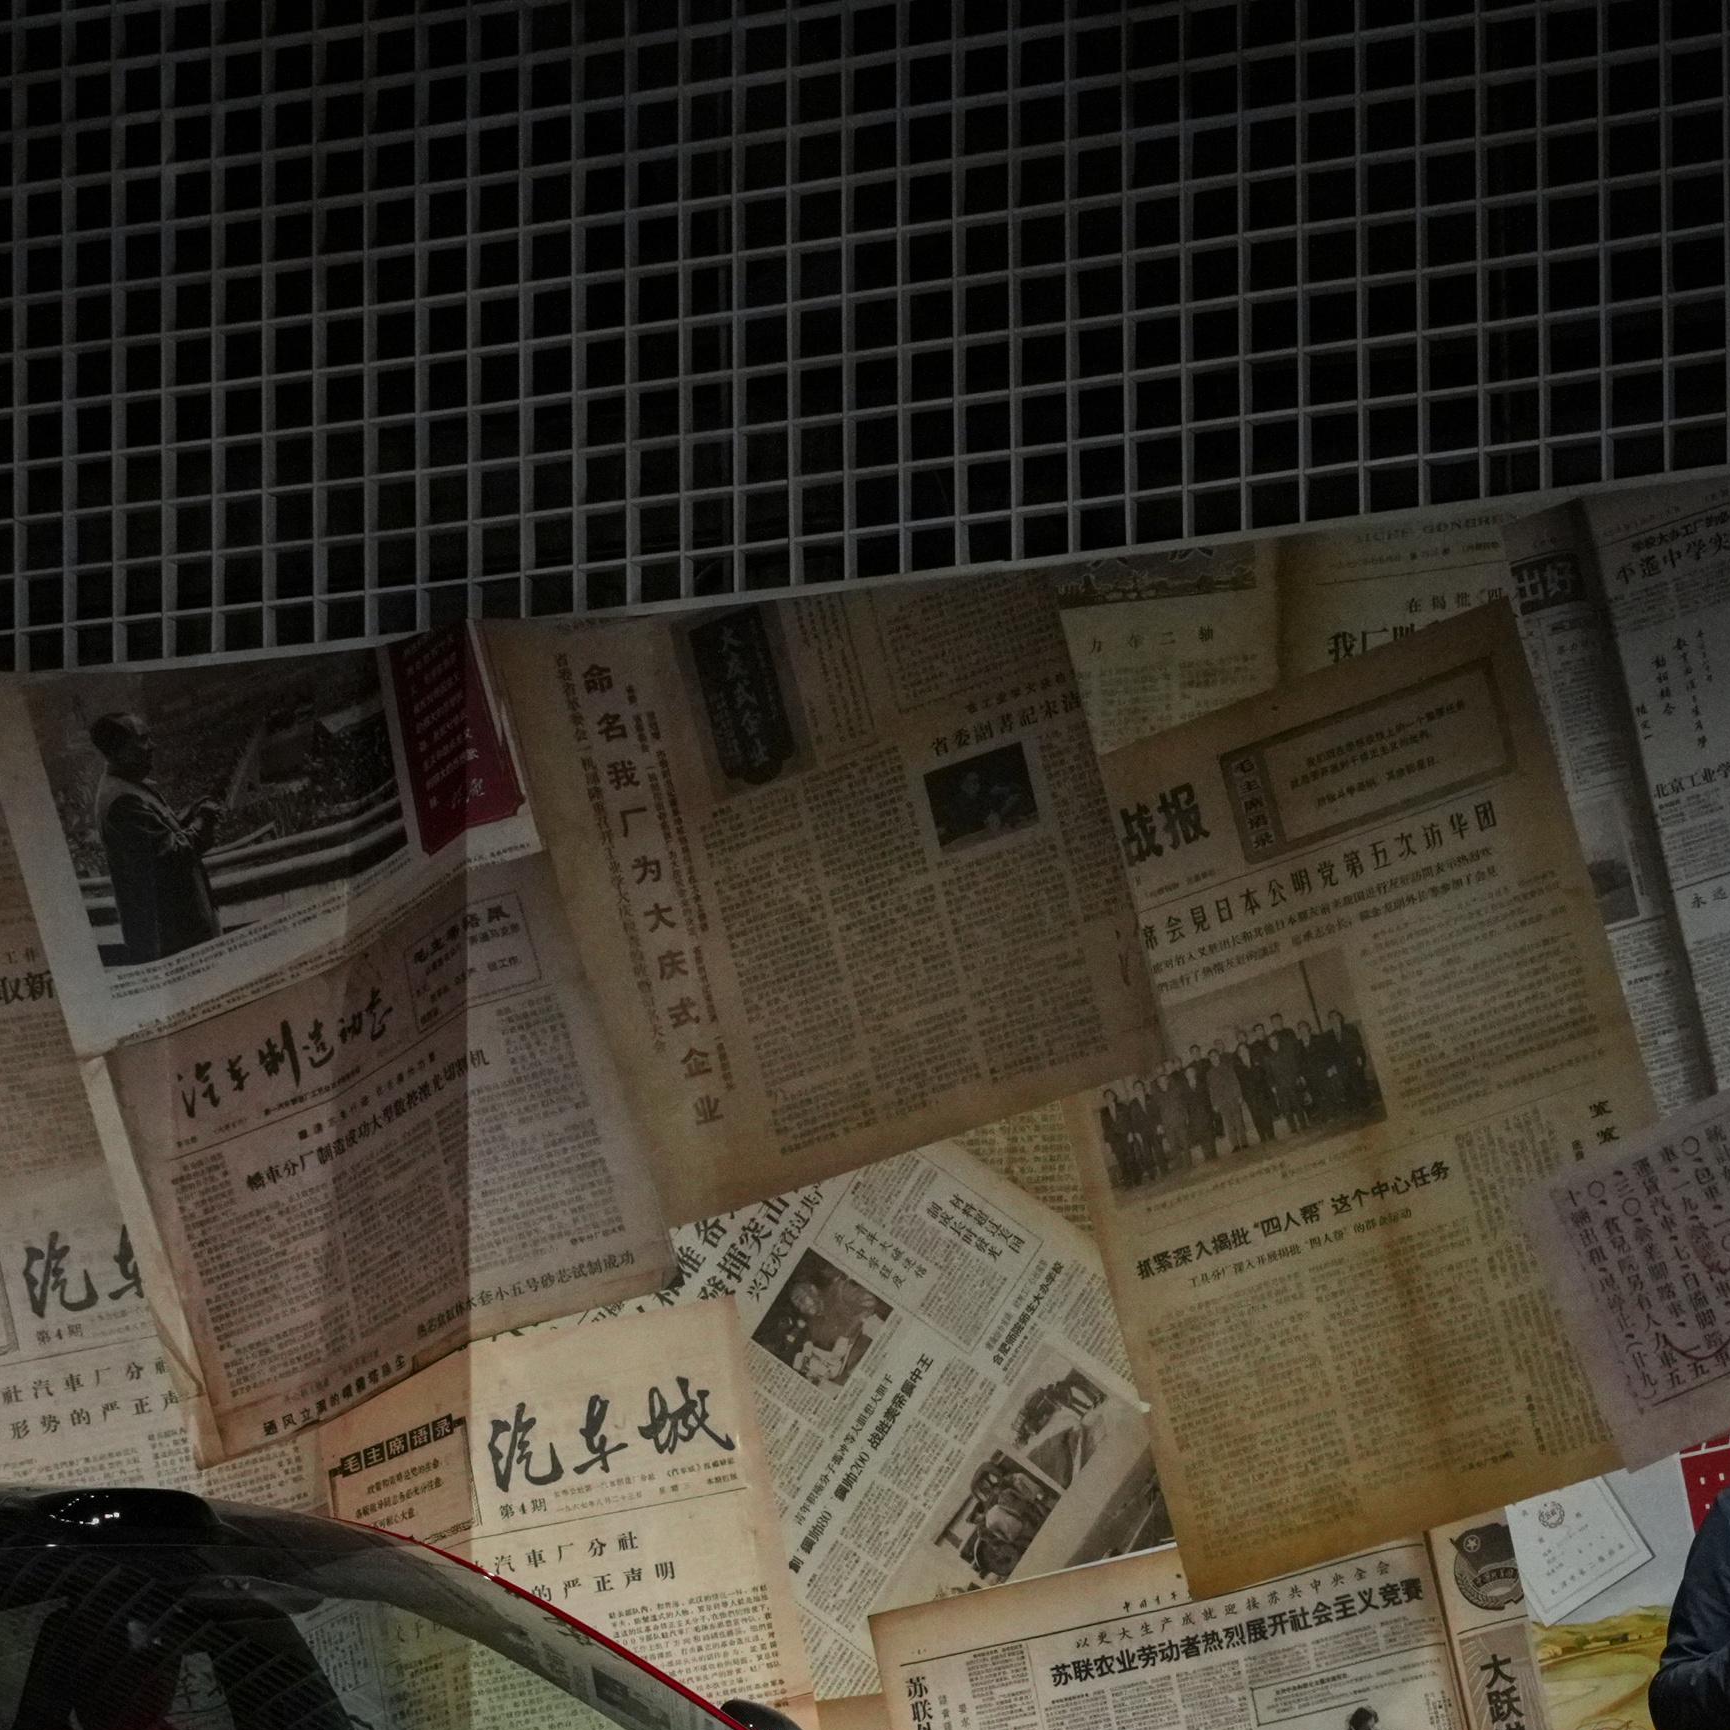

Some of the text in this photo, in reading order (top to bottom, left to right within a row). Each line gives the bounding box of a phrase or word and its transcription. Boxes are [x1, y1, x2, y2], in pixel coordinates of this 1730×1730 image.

[1119, 782, 1211, 867] 战报
[1142, 799, 1499, 951] 席会見日本公明党第五次访华团
[581, 661, 725, 1127] 命名我厂为大庆式企业
[1136, 1160, 1452, 1281] 抓紧深入揭批“四人帮”这个中心任务
[343, 1417, 453, 1475] 毛主席语录
[488, 1375, 735, 1493] 汽车城
[500, 1496, 548, 1519] 第4期
[1050, 1575, 1425, 1689] 苏联农业劳动者热烈展开社会主义竞赛
[1074, 1558, 1393, 1650] 以更大生产成就迎接苏共中央全会
